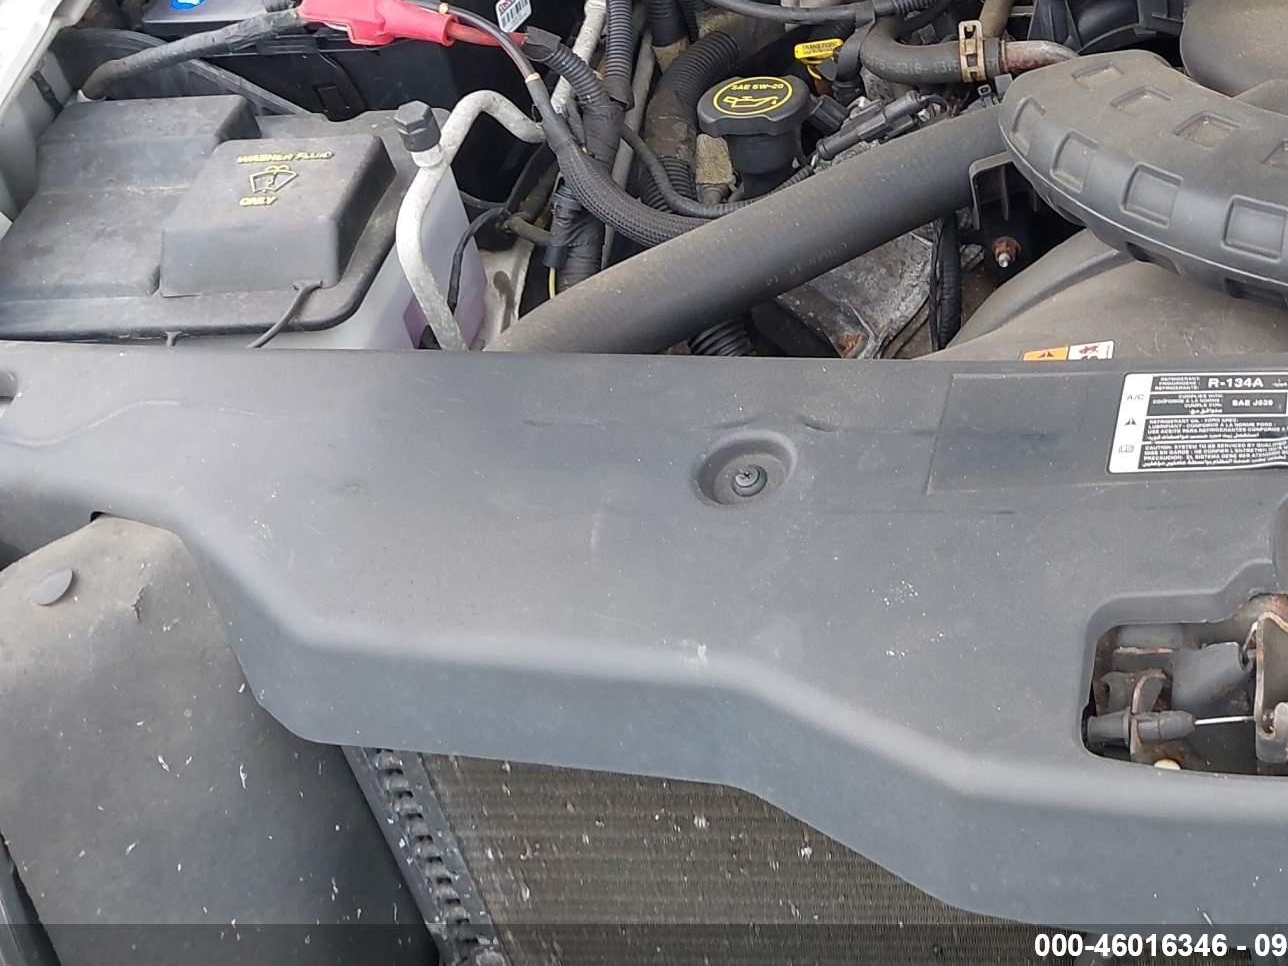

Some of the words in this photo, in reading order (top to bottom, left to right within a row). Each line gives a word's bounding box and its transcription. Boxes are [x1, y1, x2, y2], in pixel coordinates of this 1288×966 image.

[296, 151, 334, 161] FLUID
[239, 196, 278, 206] ONLY
[1207, 377, 1264, 388] R-134A
